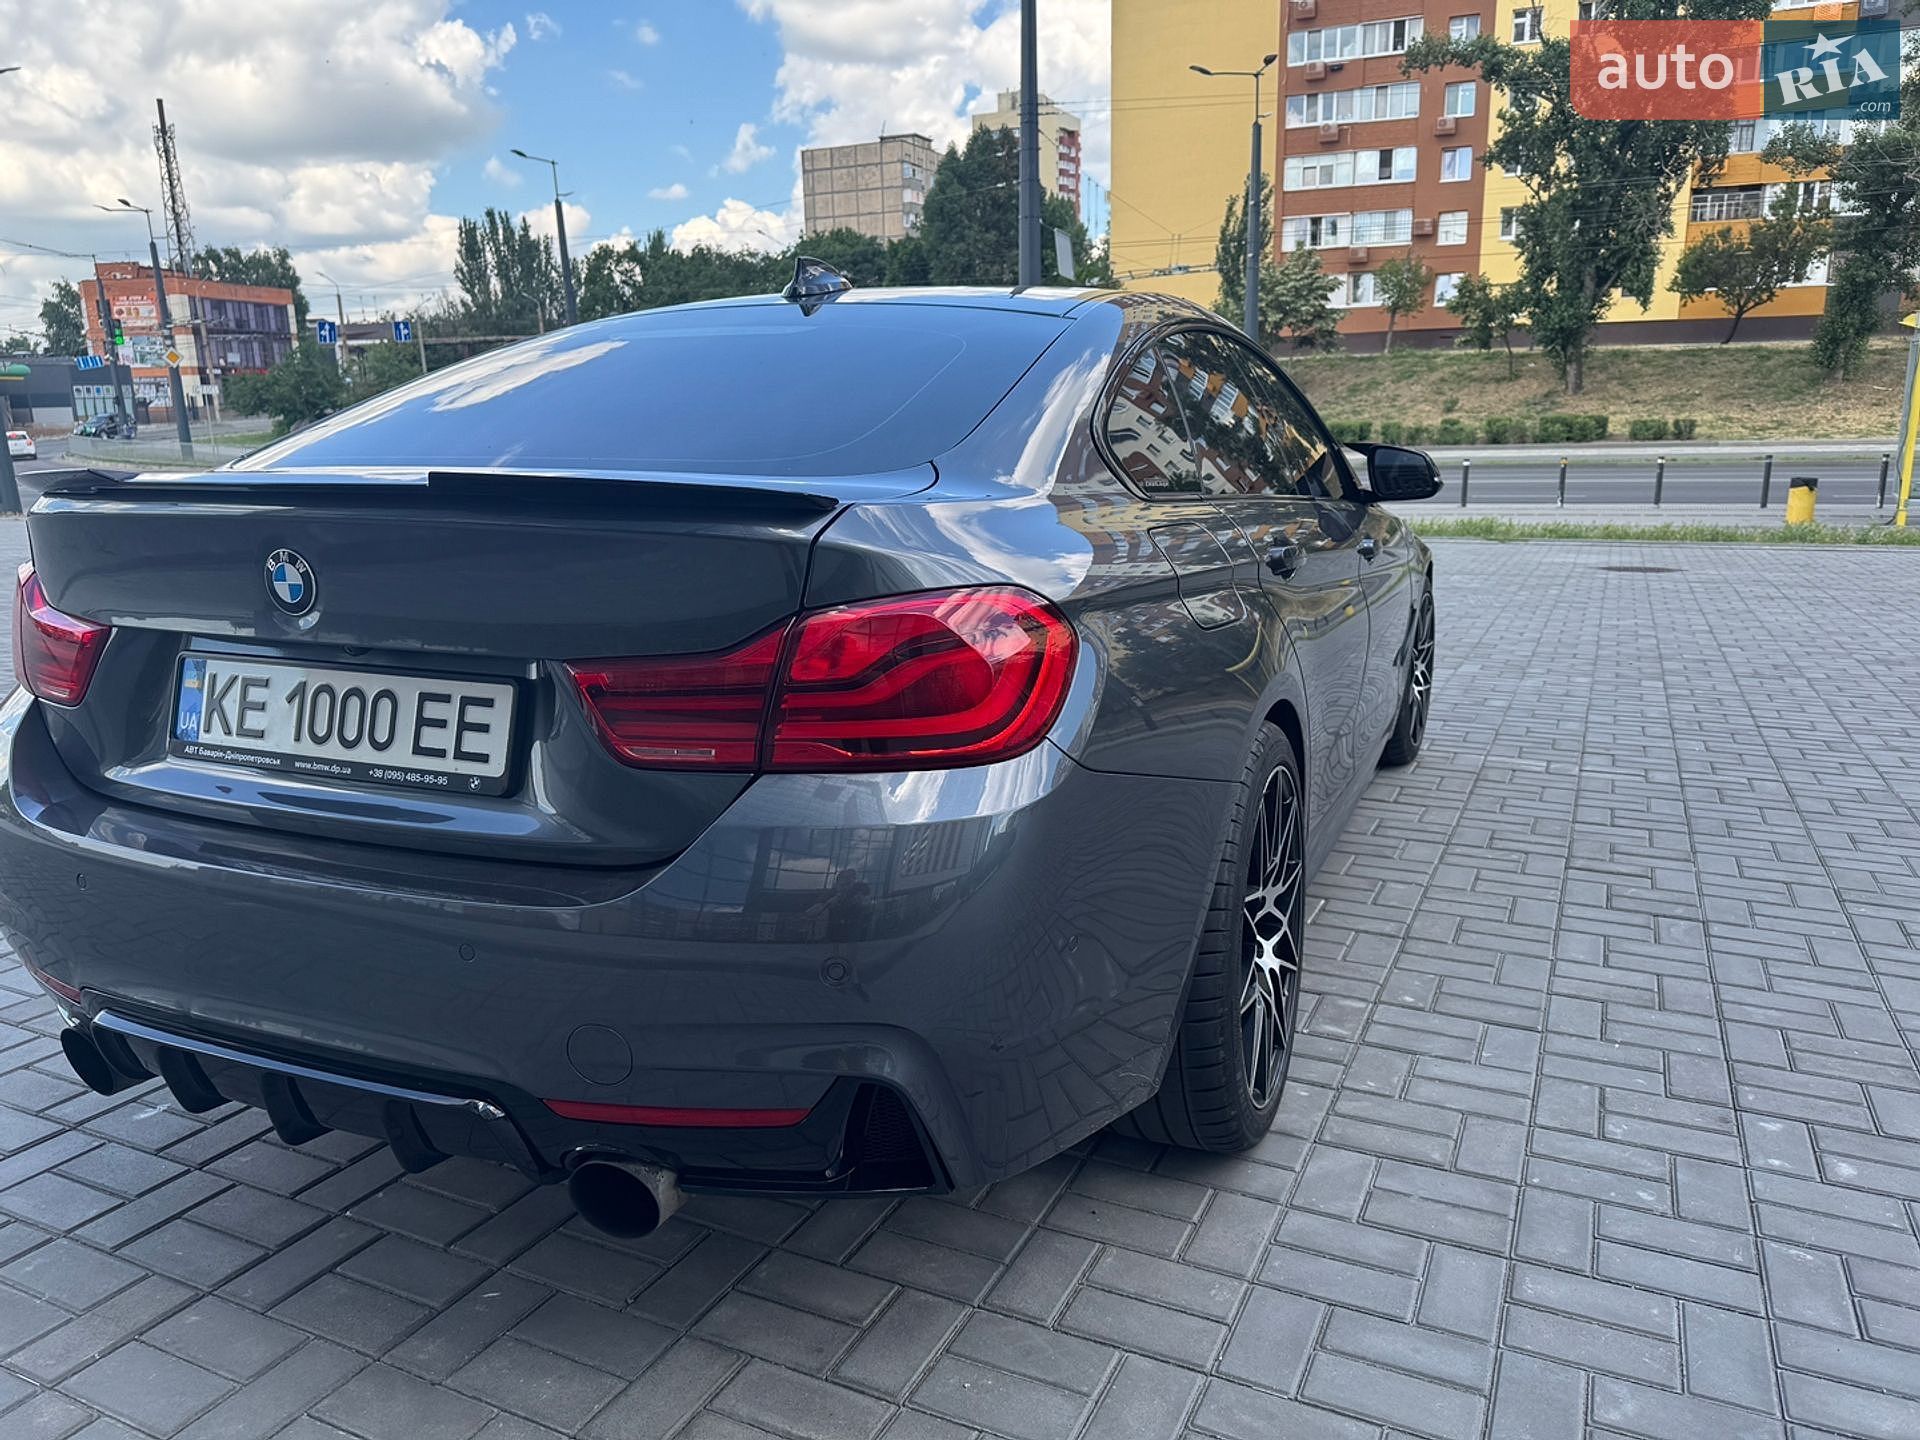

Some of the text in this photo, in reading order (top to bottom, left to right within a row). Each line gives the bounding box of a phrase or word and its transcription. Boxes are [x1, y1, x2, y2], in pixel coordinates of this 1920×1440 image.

[267, 551, 307, 574] BMW
[180, 711, 198, 730] UA
[203, 672, 495, 763] KE 1000 EE
